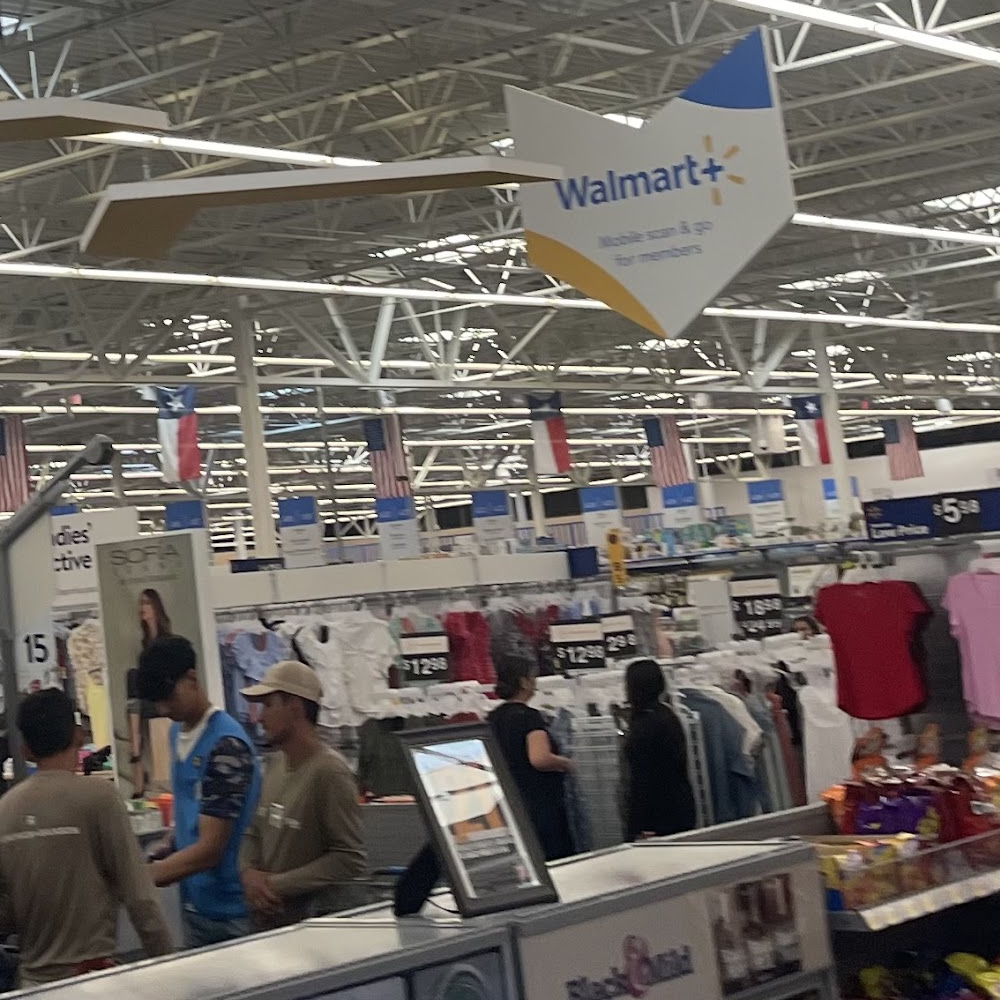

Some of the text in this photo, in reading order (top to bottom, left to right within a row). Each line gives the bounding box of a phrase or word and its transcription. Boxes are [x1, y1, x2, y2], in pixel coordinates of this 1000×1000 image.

[555, 154, 724, 210] Walmart+
[679, 220, 692, 235] &
[54, 550, 93, 572] ctive
[24, 633, 49, 664] 15
